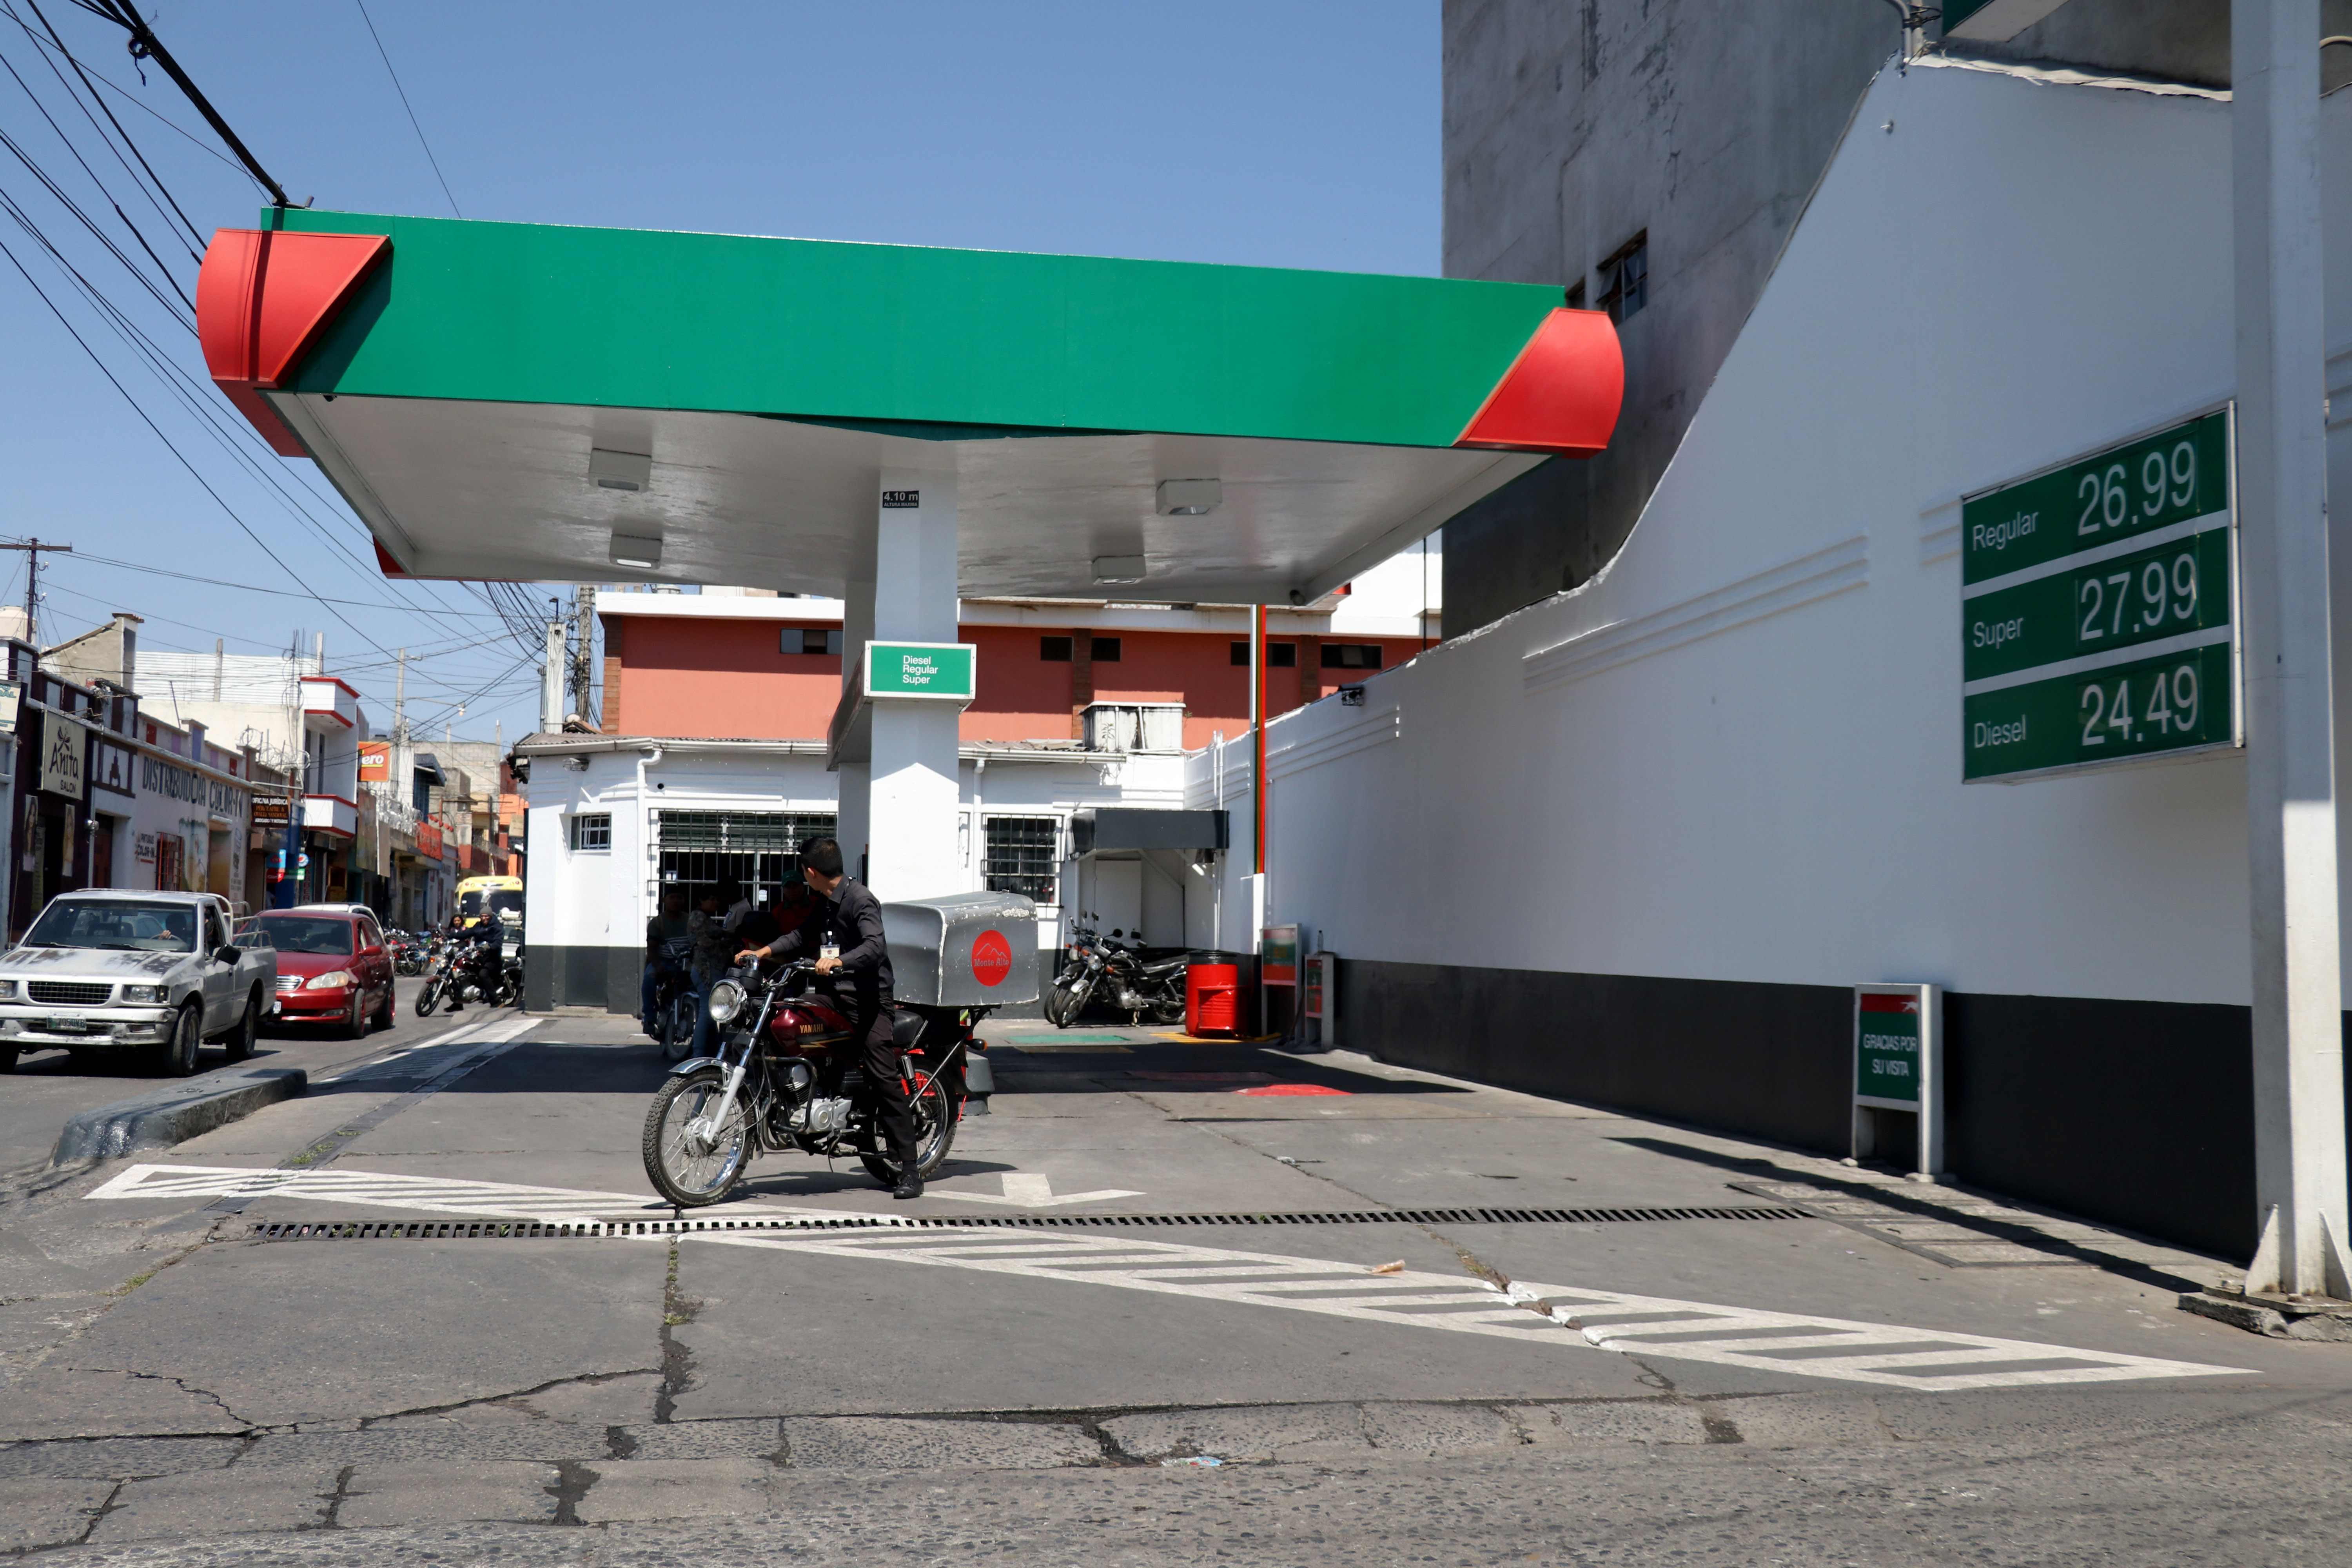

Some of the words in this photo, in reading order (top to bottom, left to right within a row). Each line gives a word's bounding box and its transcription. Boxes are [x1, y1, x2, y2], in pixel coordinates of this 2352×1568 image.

[884, 492, 906, 501] 4.10
[1973, 511, 2039, 551] Regular
[2078, 441, 2196, 536] 26.99
[1973, 617, 2024, 649] Super
[2080, 553, 2197, 641] 27.99
[903, 655, 931, 665] Diesel
[903, 664, 939, 675] Regular
[902, 674, 931, 686] Super
[1974, 715, 2026, 749] Diesel
[2081, 666, 2198, 746] 24.49
[49, 742, 78, 780] Anita
[60, 780, 76, 793] SALON
[143, 755, 206, 807] DISTRIBUIDORA
[996, 958, 1009, 966] Alto
[800, 1024, 824, 1033] YAMAHA
[1863, 1033, 1899, 1051] GRACIAS
[1900, 1036, 1917, 1052] POR
[1872, 1058, 1885, 1074] SU
[1885, 1060, 1909, 1076] VISITA
